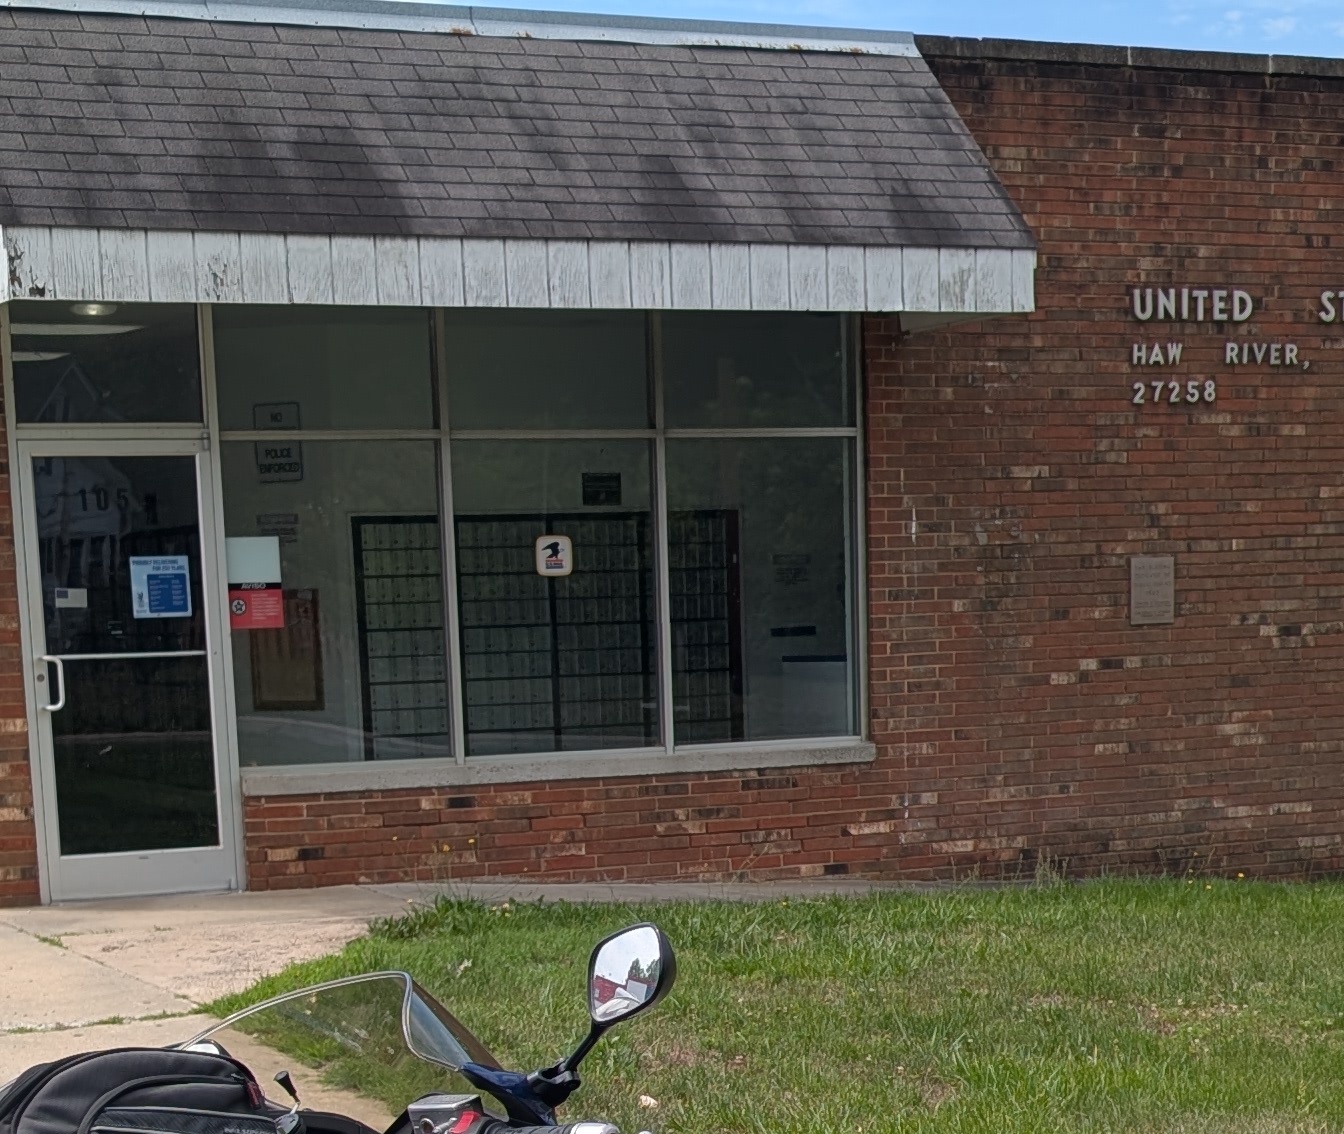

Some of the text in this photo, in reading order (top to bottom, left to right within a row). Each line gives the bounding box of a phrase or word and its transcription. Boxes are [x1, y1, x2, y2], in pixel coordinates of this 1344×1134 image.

[1133, 288, 1253, 321] UNITED
[1132, 342, 1183, 366] HAW
[1225, 342, 1310, 370] RIVER,
[1133, 380, 1216, 403] 27258
[79, 487, 129, 512] 105
